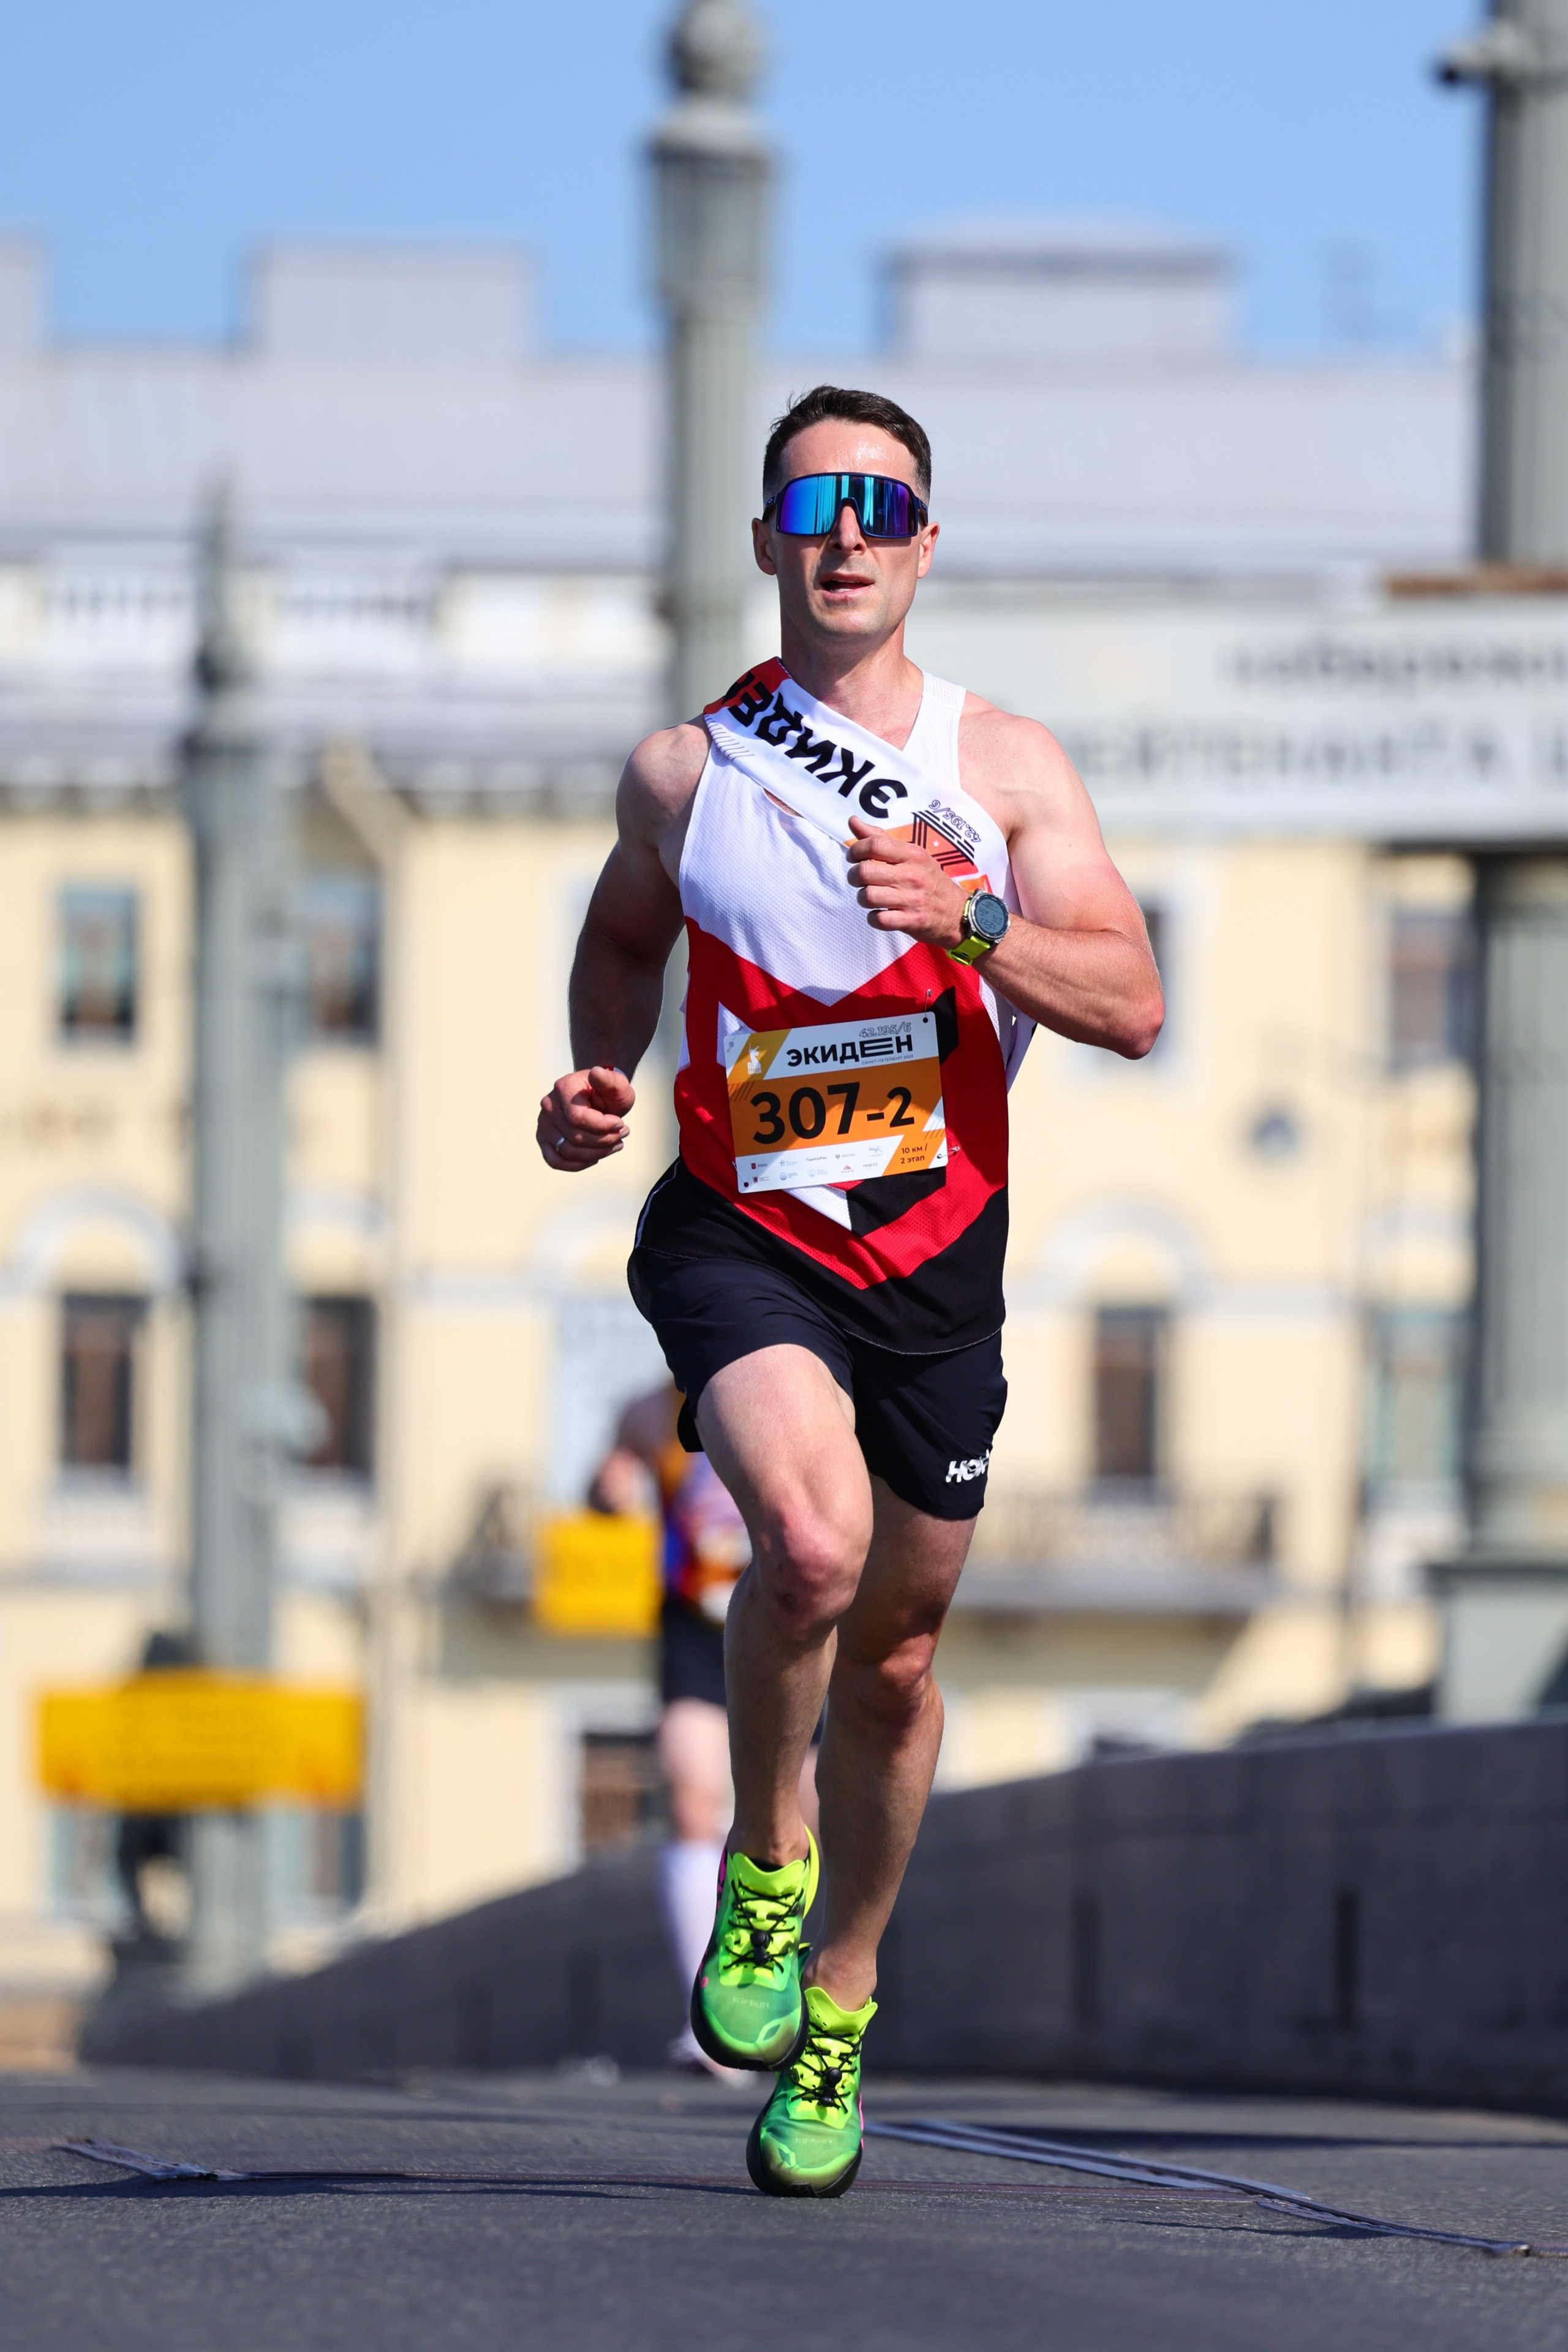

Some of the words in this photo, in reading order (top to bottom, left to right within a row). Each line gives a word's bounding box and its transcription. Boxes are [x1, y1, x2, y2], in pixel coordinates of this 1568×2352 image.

[929, 799, 981, 843] 42.195/6
[859, 1021, 912, 1038] 42.195/6
[786, 1034, 913, 1067] ЭКИДЕН
[862, 1055, 903, 1065] САНКТ-ПЕТЕРБУРГ
[750, 1081, 915, 1144] 307-2
[924, 1142, 928, 1152] /
